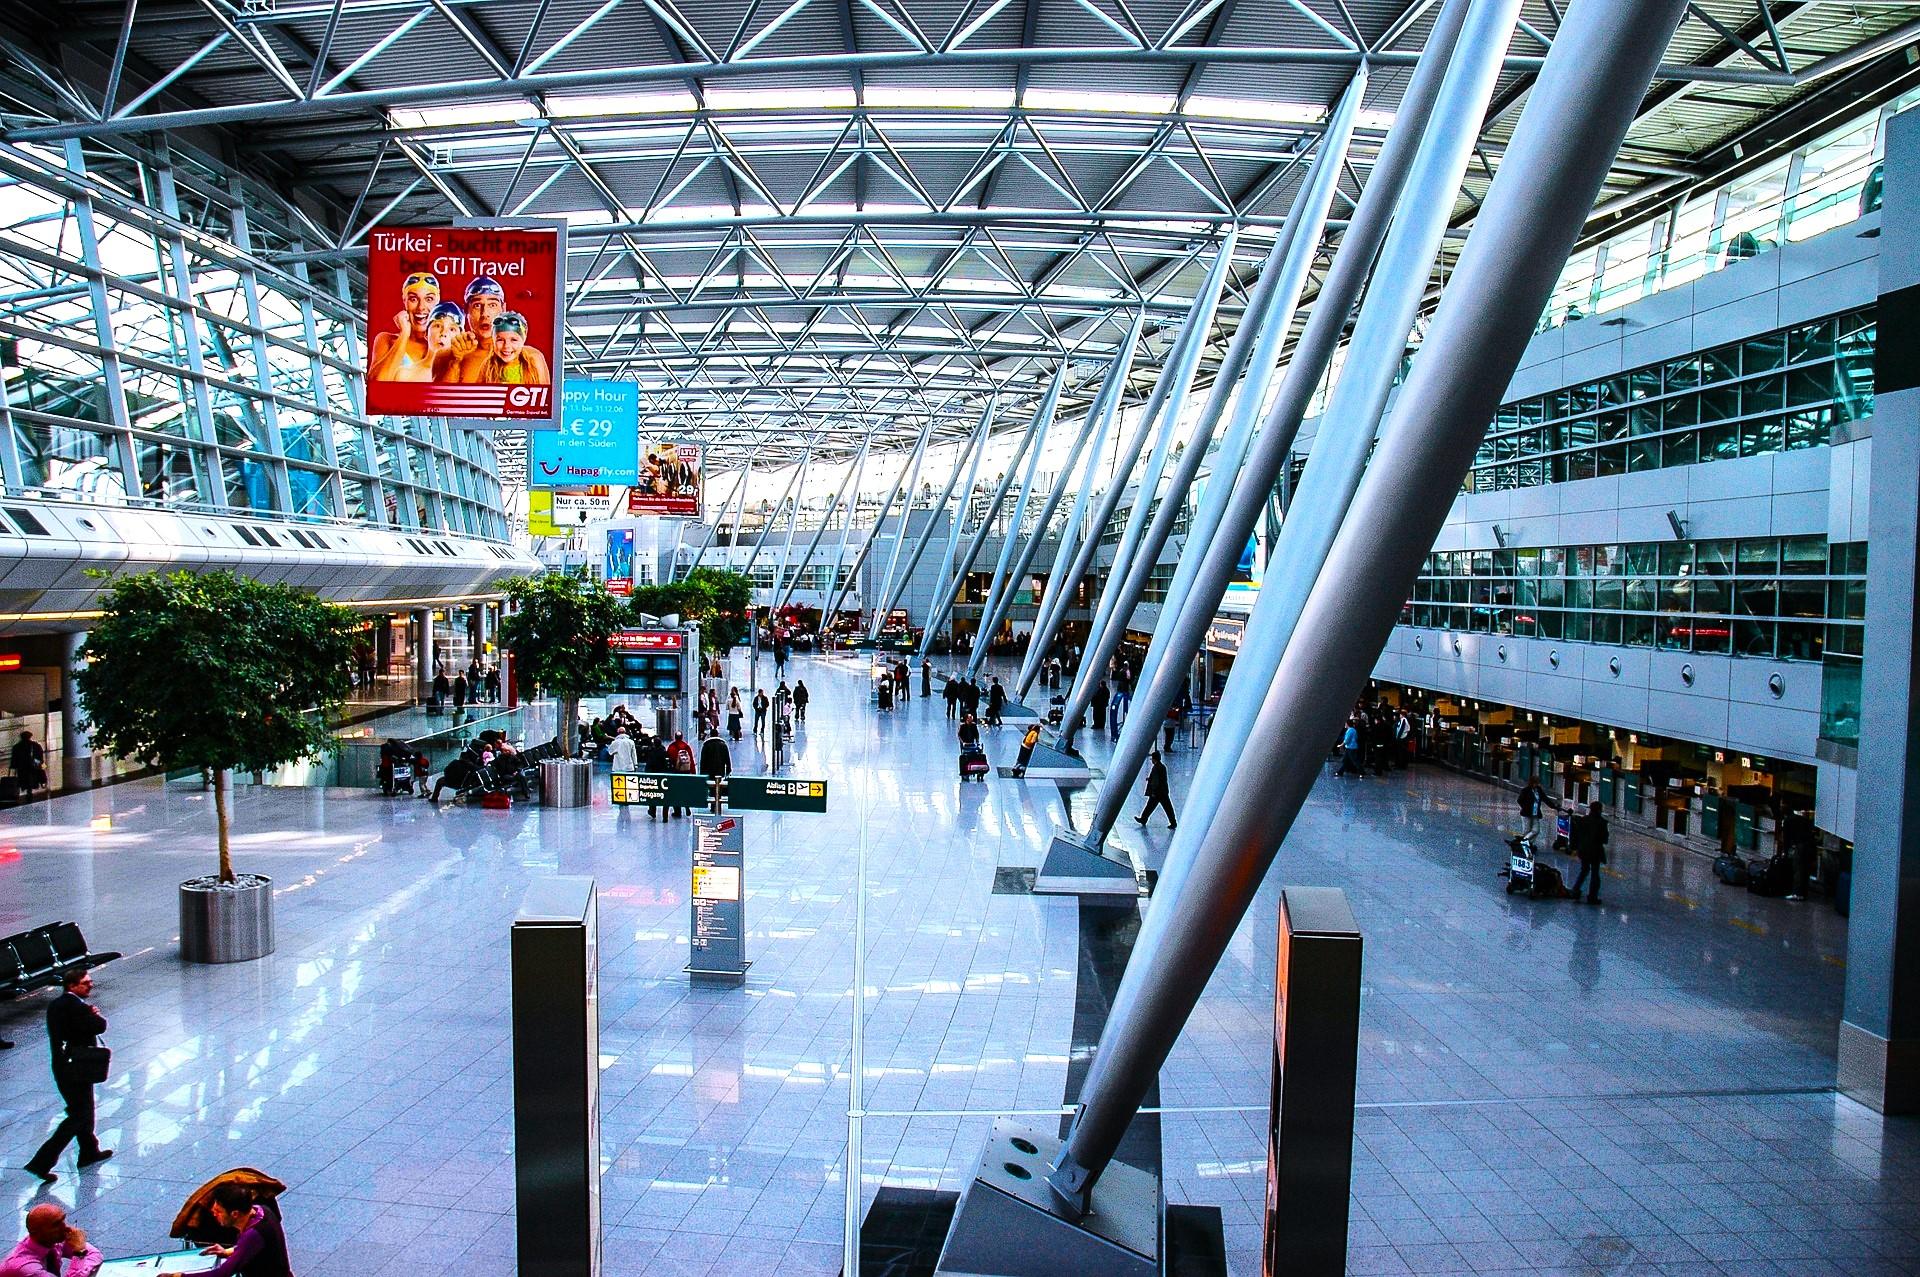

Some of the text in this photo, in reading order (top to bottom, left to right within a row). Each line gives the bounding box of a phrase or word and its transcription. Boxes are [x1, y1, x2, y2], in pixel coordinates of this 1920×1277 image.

[374, 233, 431, 251] Türkei
[448, 234, 501, 253] bucht
[508, 239, 551, 254] man
[401, 256, 525, 276] bei GTI Travel
[594, 388, 628, 402] Hour
[571, 418, 585, 436] €
[588, 419, 613, 437] 29
[557, 438, 617, 448] in den Süden
[680, 448, 696, 456] LTU
[567, 465, 635, 477] Hapagfly.com
[556, 497, 572, 505] Nur
[574, 498, 587, 506] ca.
[589, 497, 601, 506] 50
[639, 777, 669, 790] Abflug C
[766, 781, 796, 795] Abflug B
[639, 790, 665, 799] Ausgang
